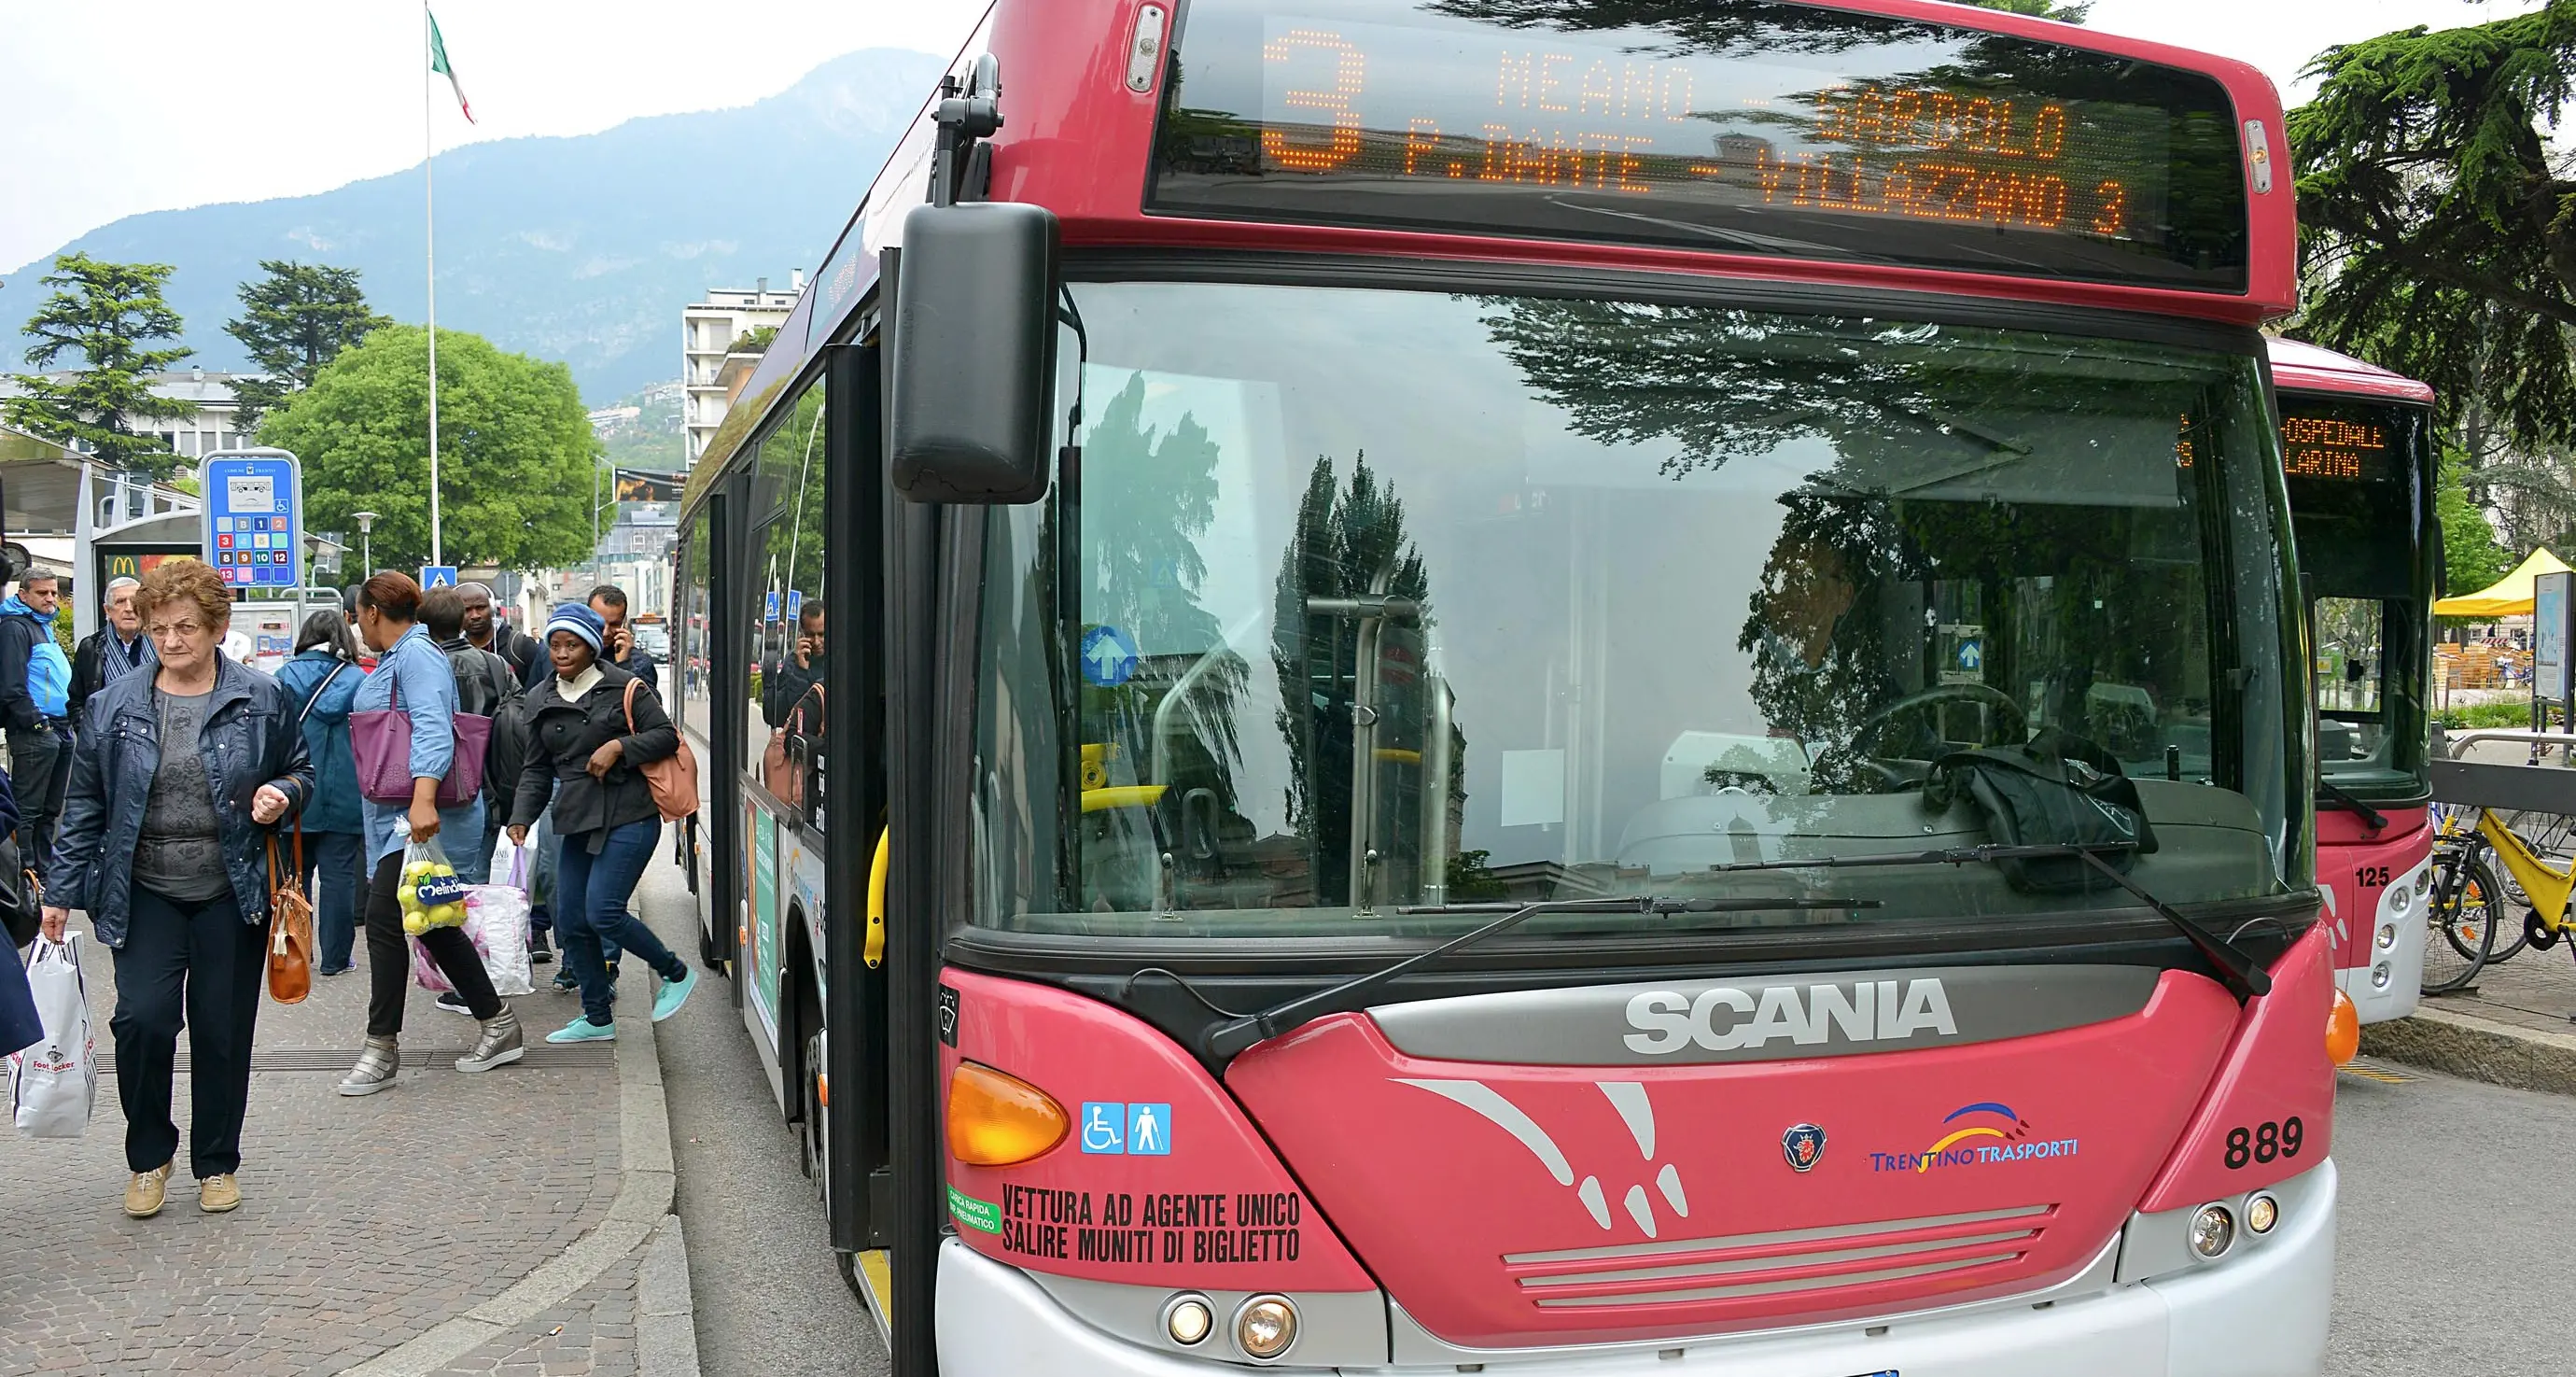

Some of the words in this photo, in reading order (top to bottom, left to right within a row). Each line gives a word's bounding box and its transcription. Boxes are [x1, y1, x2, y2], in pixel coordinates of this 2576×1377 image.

[1262, 29, 1365, 168] 3
[1496, 50, 1694, 121] MEANO
[1816, 84, 2065, 160] GARDOLO
[1757, 148, 2065, 228] VILLAZZANO
[2093, 180, 2125, 233] 3
[2285, 448, 2359, 477] LARINA
[258, 520, 264, 529] 1
[275, 520, 283, 528] 2
[221, 537, 230, 545] 3
[223, 554, 231, 563] 8
[241, 554, 248, 563] 9
[256, 554, 269, 563] 10
[274, 553, 287, 562] 12
[221, 570, 233, 579] 13
[2355, 866, 2389, 888] 125
[1622, 977, 1959, 1055] SCANIA
[2223, 1116, 2303, 1170] 889
[1869, 1148, 1975, 1173] TRENTINO
[1977, 1139, 2079, 1164] TRASPORTI
[965, 1200, 990, 1216] RAPIDA
[1001, 1182, 1094, 1226] VETTURA
[1102, 1192, 1132, 1227] AD
[1141, 1193, 1226, 1228] AGENTE
[1236, 1191, 1300, 1228] UNICO
[1001, 1218, 1069, 1259] SALIRE
[1077, 1228, 1154, 1263] MUNITI
[1163, 1230, 1183, 1263] DI
[1193, 1228, 1300, 1263] BIGLIETTO
